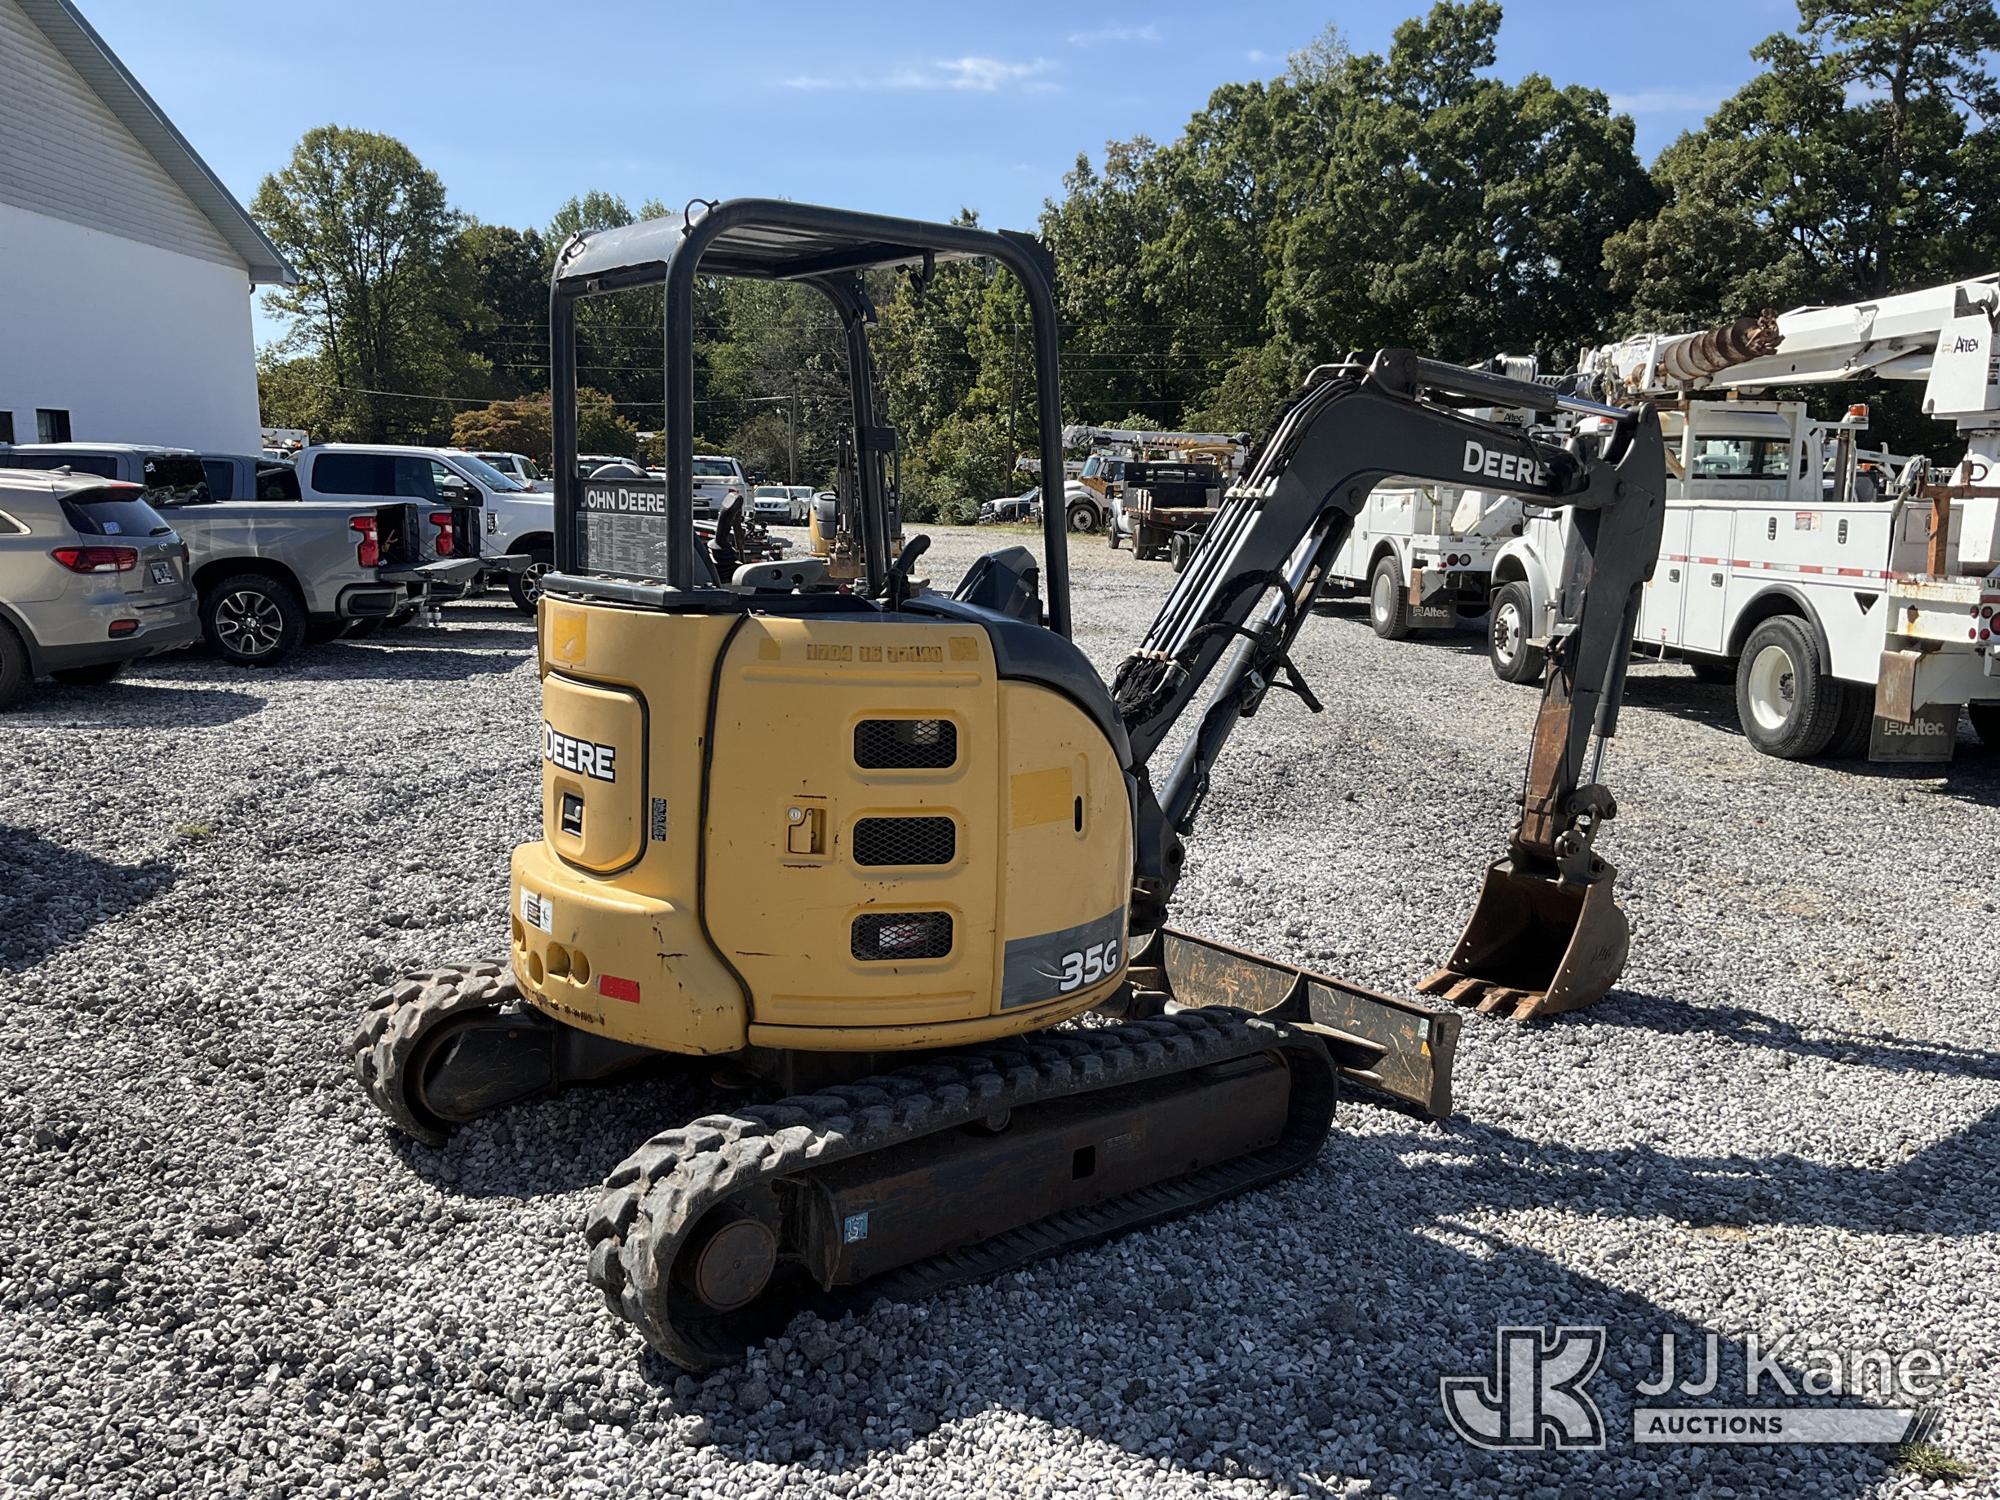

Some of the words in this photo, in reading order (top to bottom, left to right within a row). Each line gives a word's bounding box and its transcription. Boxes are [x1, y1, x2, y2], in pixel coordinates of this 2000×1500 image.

[1463, 440, 1551, 487] DEERE
[581, 486, 615, 509] JOHN
[618, 488, 665, 512] DEERE
[1423, 607, 1449, 617] Altec
[545, 720, 615, 782] DEERE
[1059, 939, 1117, 991] 35G
